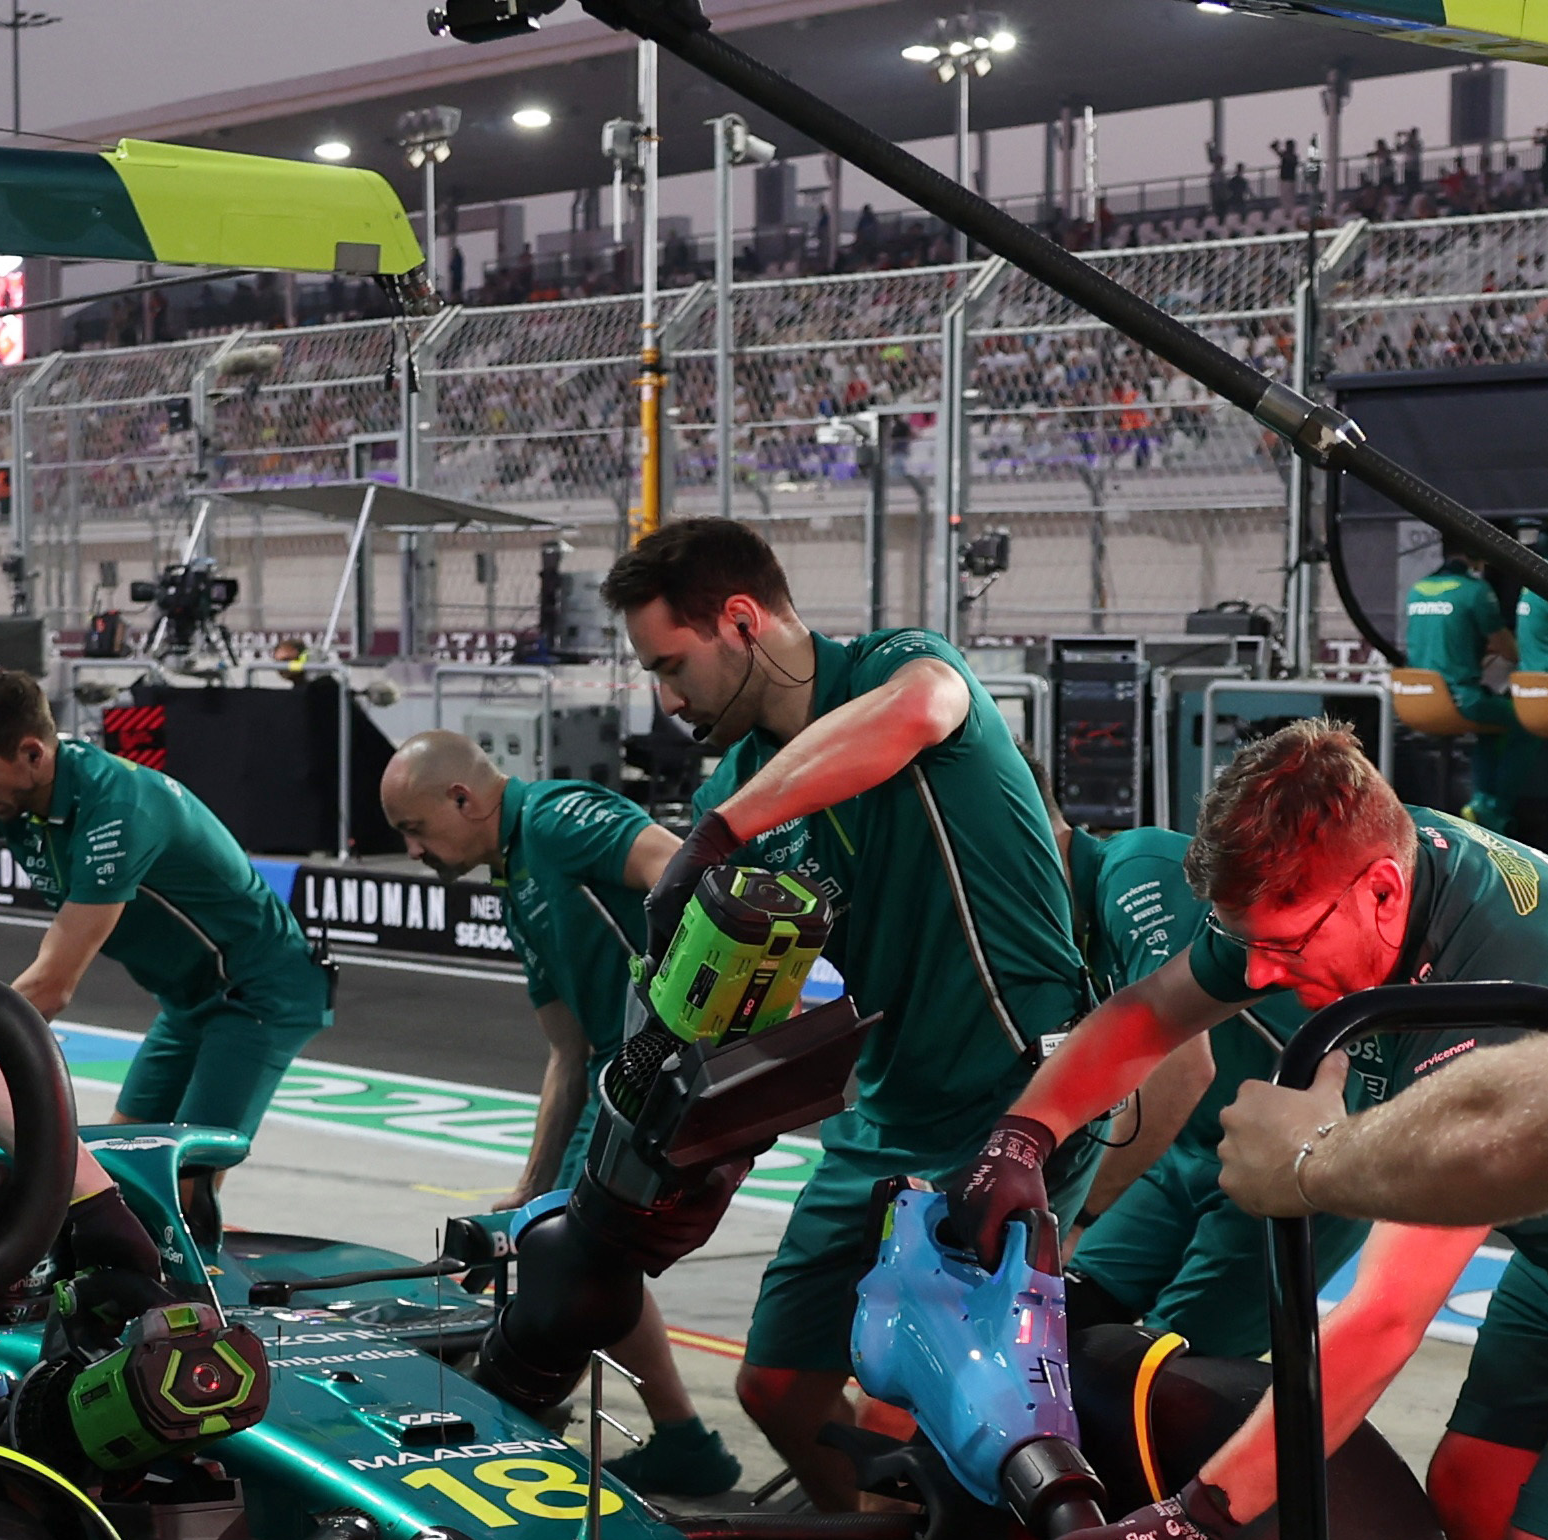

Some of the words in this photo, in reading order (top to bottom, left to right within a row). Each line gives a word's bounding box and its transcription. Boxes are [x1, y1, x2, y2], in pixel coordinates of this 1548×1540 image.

[432, 632, 517, 665] ATAR
[304, 873, 447, 932] LANDMAN
[1413, 1037, 1476, 1075] servicenow
[267, 1348, 420, 1369] mbardier
[347, 1438, 569, 1471] MAADEN
[399, 1457, 625, 1530] 18
